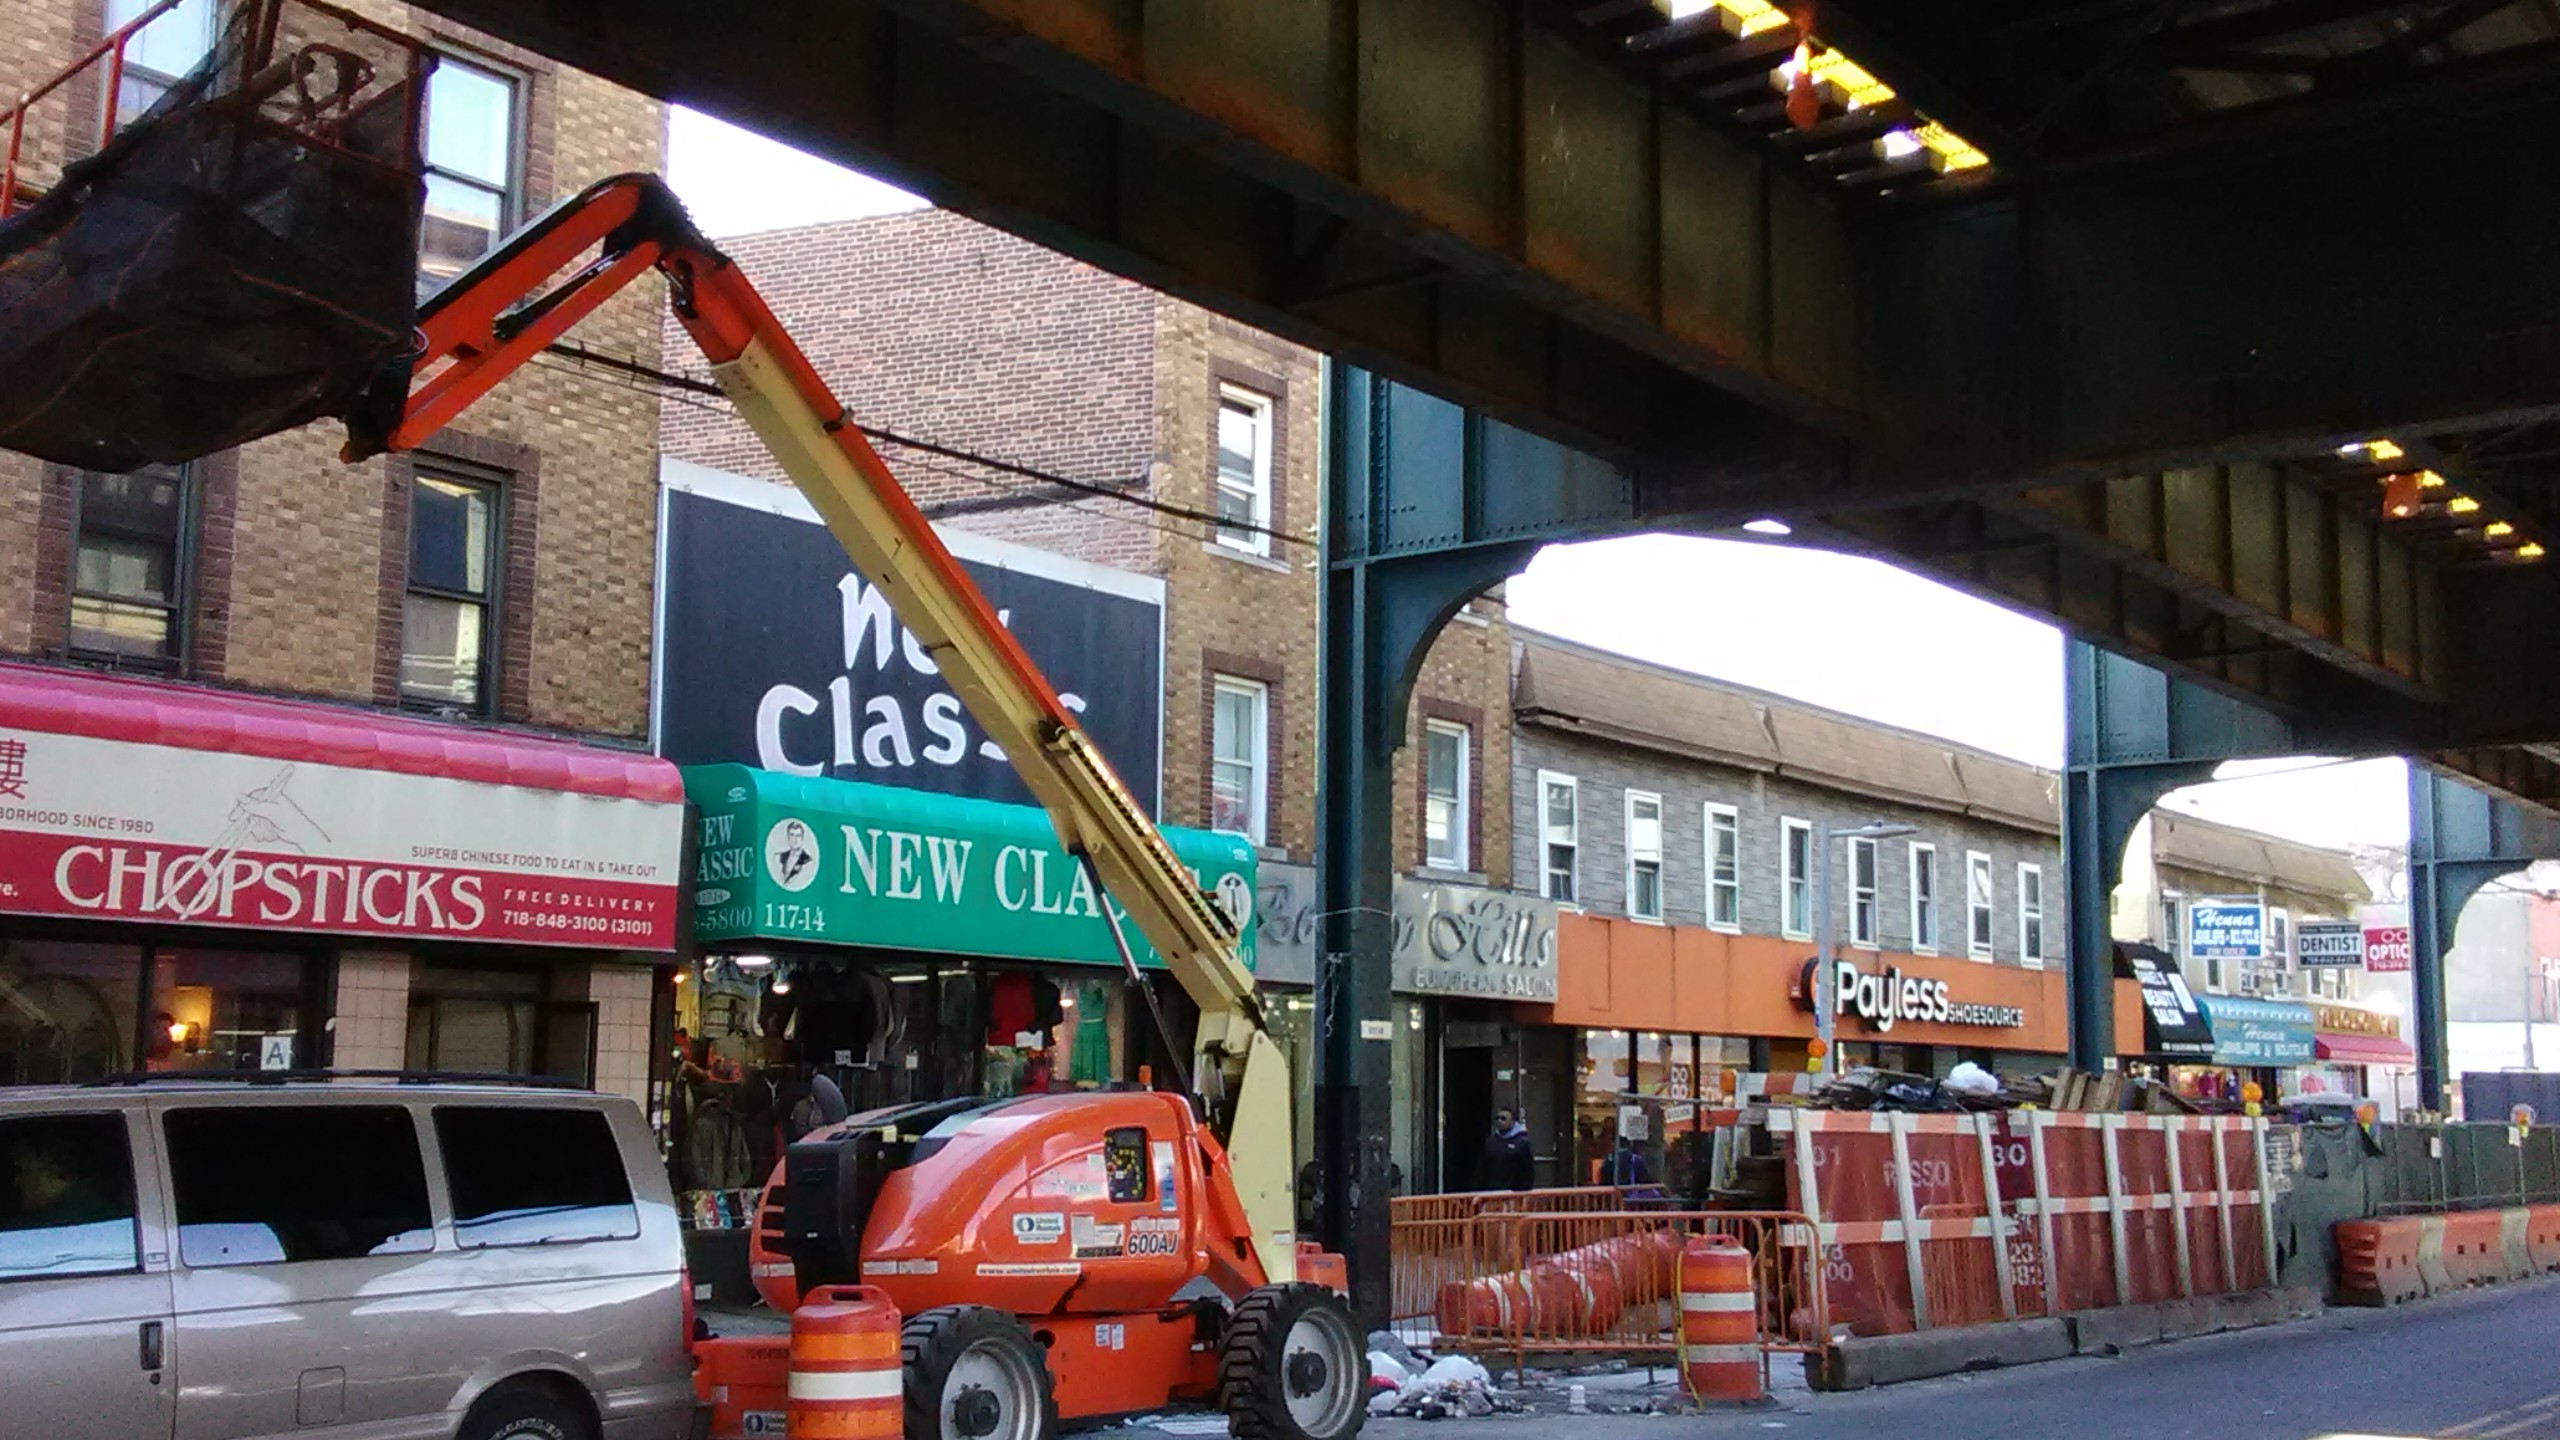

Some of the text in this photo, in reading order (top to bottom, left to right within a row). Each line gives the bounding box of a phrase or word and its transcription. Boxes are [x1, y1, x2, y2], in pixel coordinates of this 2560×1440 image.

[73, 813, 116, 830] SINCE
[120, 819, 154, 833] 1980
[697, 814, 735, 847] EW
[411, 846, 458, 860] SUPERB
[461, 850, 510, 865] CHINESE
[512, 854, 542, 868] FOOD
[546, 857, 559, 869] TO
[561, 859, 582, 871] EAT
[584, 861, 595, 872] IN
[608, 862, 634, 875] TAKE
[636, 864, 657, 877] OUT
[696, 846, 754, 882] ASSIC
[839, 824, 973, 905] NEW
[55, 844, 485, 931] CHOPSTICKS
[503, 888, 655, 912] FREE DELIVERY
[503, 910, 653, 935] 718-848-3100 (3101)
[695, 906, 753, 930] -5800
[765, 903, 826, 932] 117-14
[2301, 936, 2358, 952] DENTIST
[2369, 944, 2410, 960] OPTIC
[1503, 973, 1556, 997] SALON
[1837, 962, 2024, 1033] Payless SHOESOURCE
[266, 1042, 284, 1065] A
[1883, 1159, 1950, 1188] RSSO
[1128, 1233, 1178, 1256] 600AJ
